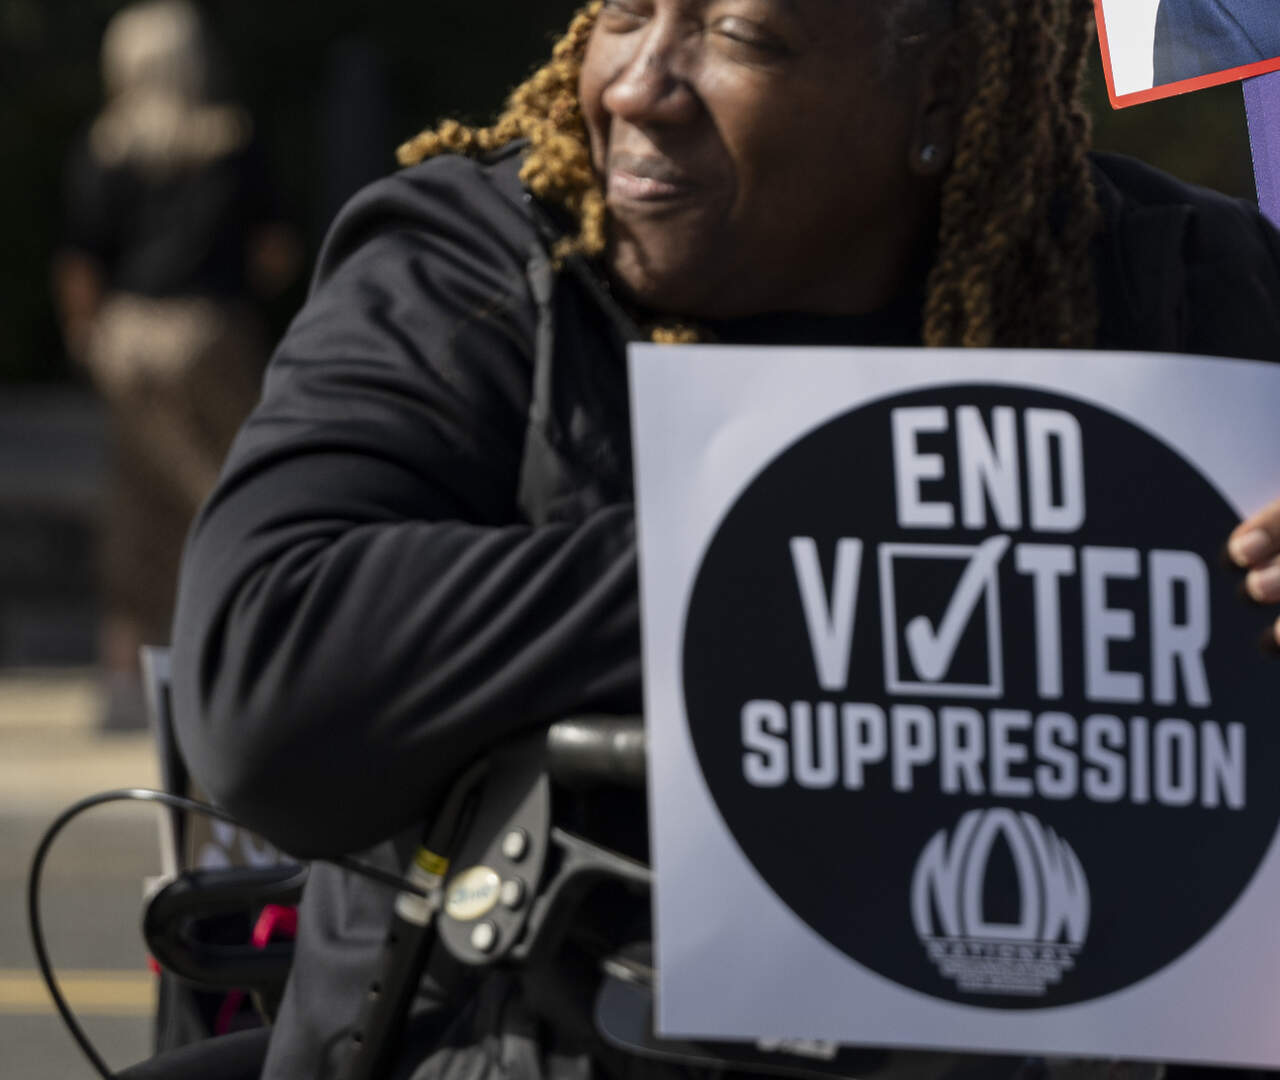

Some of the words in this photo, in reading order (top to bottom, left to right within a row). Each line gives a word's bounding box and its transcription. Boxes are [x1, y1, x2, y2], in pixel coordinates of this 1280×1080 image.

[891, 405, 1086, 534] END
[740, 698, 1247, 811] SUPPRESSION
[910, 807, 1090, 950] NOW
